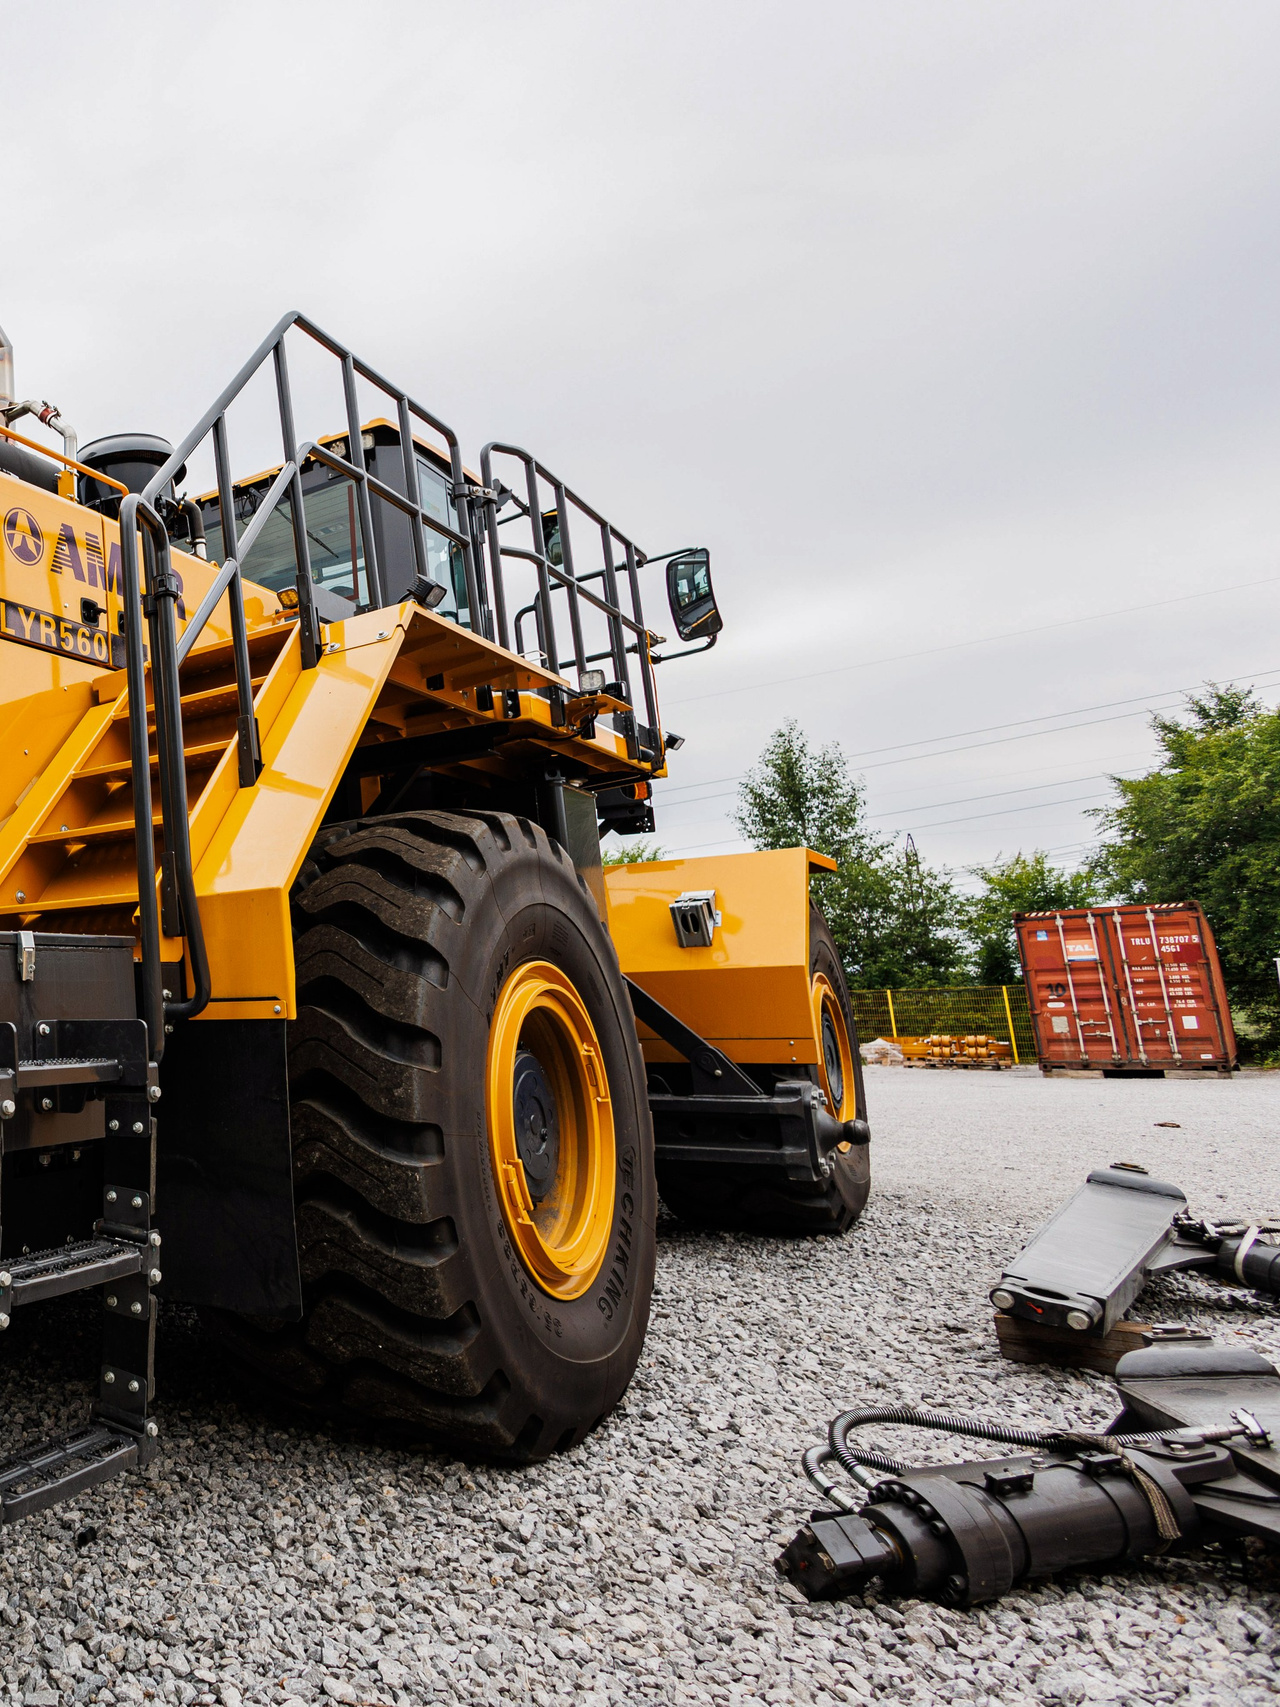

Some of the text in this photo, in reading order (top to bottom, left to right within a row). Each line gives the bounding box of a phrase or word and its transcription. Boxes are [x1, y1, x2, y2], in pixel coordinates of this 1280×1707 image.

[0, 601, 108, 661] LYR560
[1130, 937, 1151, 946] TRLU
[1159, 935, 1189, 944] 738707
[1066, 944, 1093, 952] TAL
[1160, 944, 1181, 953] 45G1
[1045, 982, 1067, 997] 10
[597, 1145, 636, 1322] TECHKING
